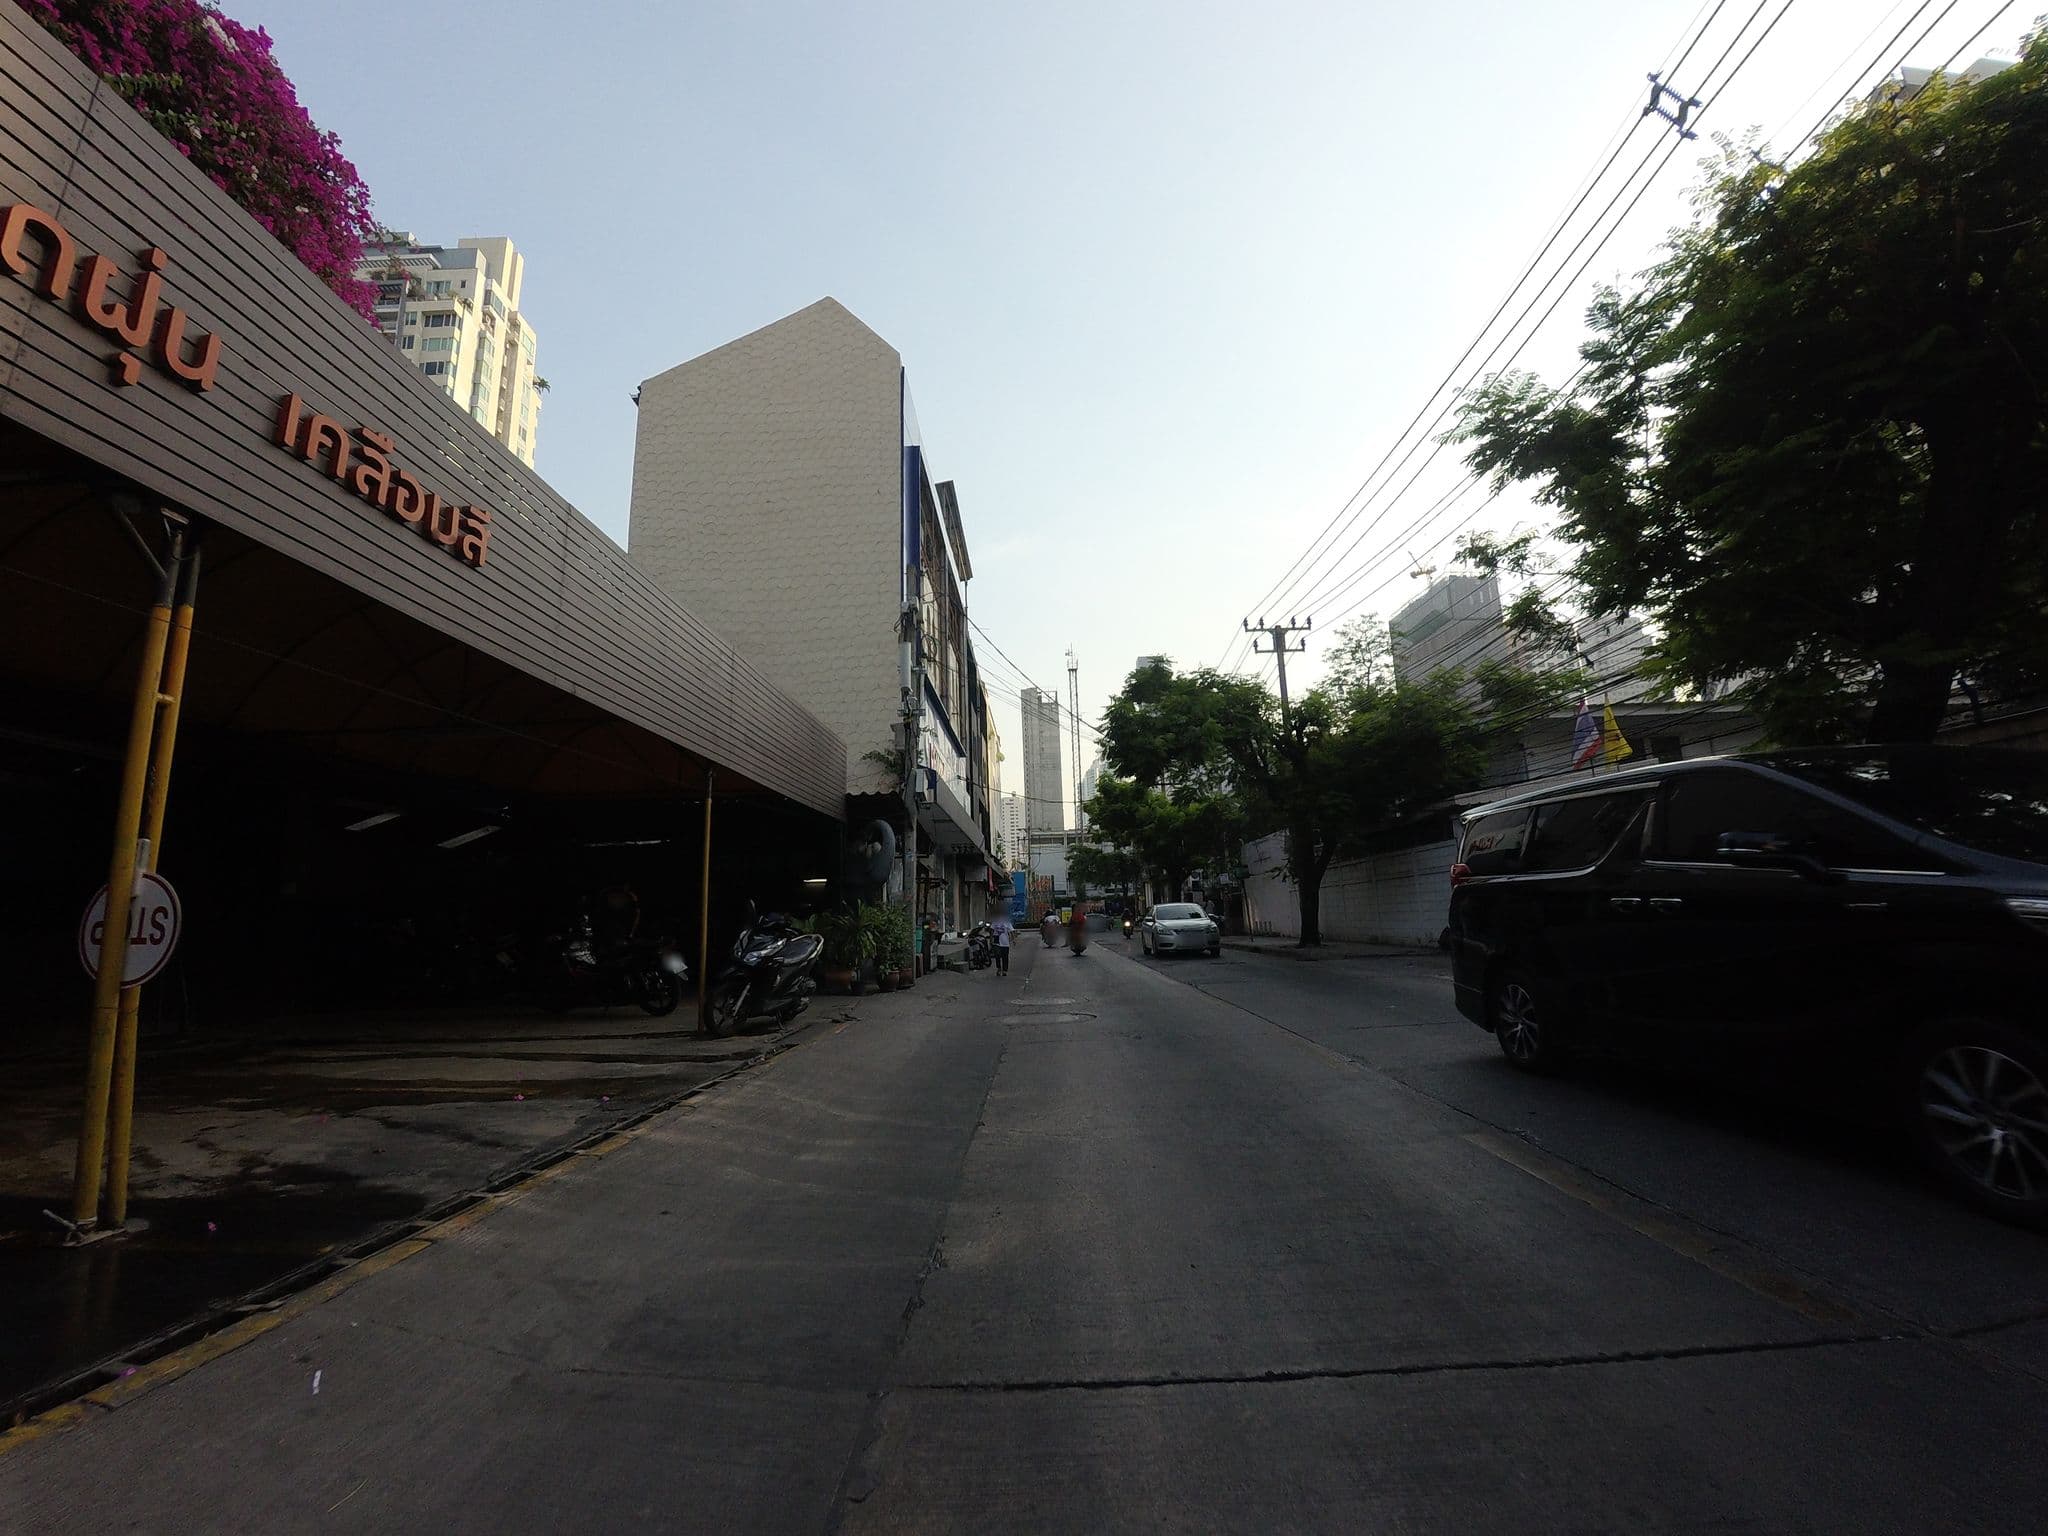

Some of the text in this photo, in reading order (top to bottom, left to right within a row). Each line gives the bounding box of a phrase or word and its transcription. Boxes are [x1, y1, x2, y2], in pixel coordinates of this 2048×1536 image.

[277, 393, 492, 567] เคลือบสี
[90, 905, 169, 946] STP
